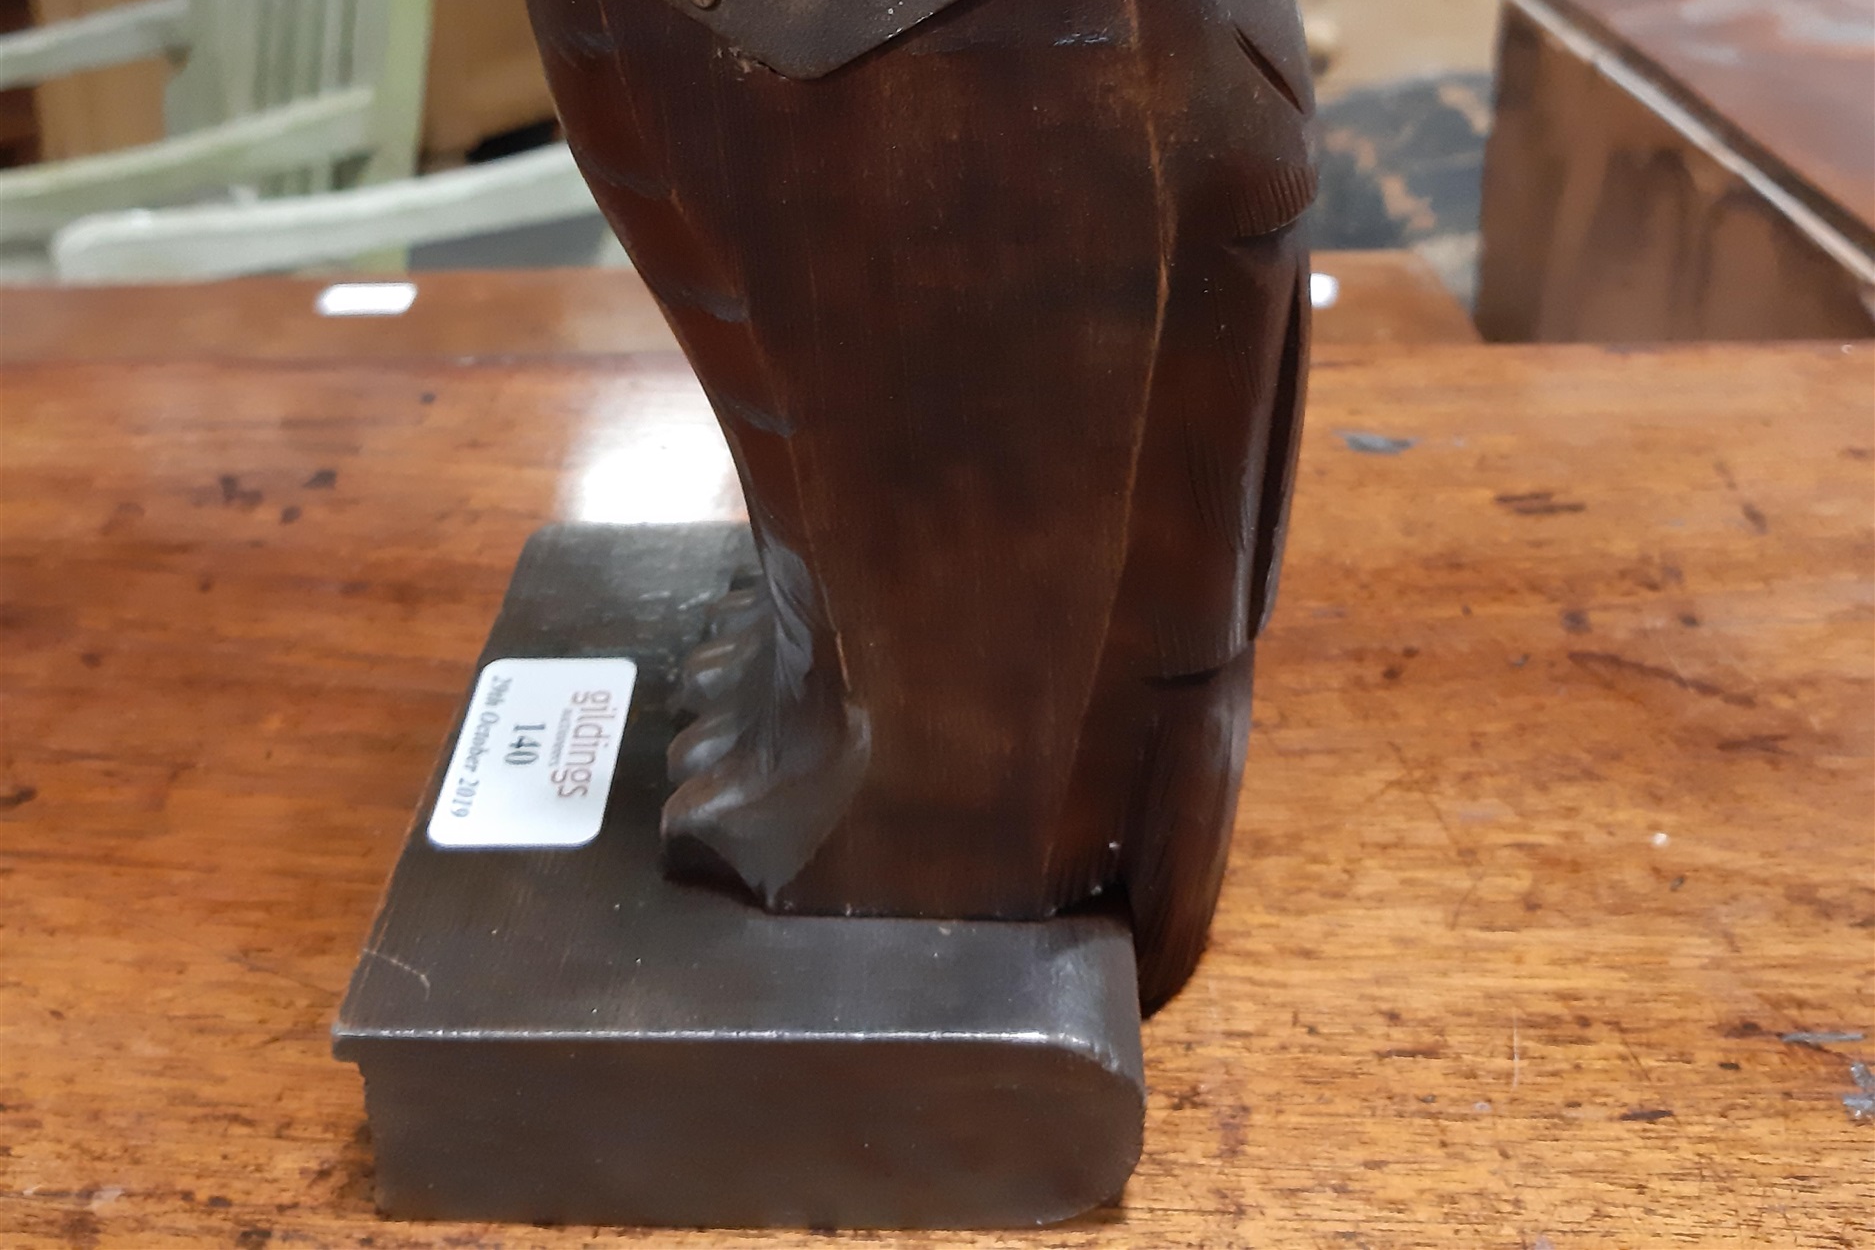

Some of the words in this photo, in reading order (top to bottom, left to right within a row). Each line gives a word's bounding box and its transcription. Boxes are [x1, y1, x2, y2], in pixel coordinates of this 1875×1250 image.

[464, 711, 500, 773] October
[504, 724, 546, 765] 140
[551, 690, 616, 798] gildings
[450, 777, 479, 818] 2019
